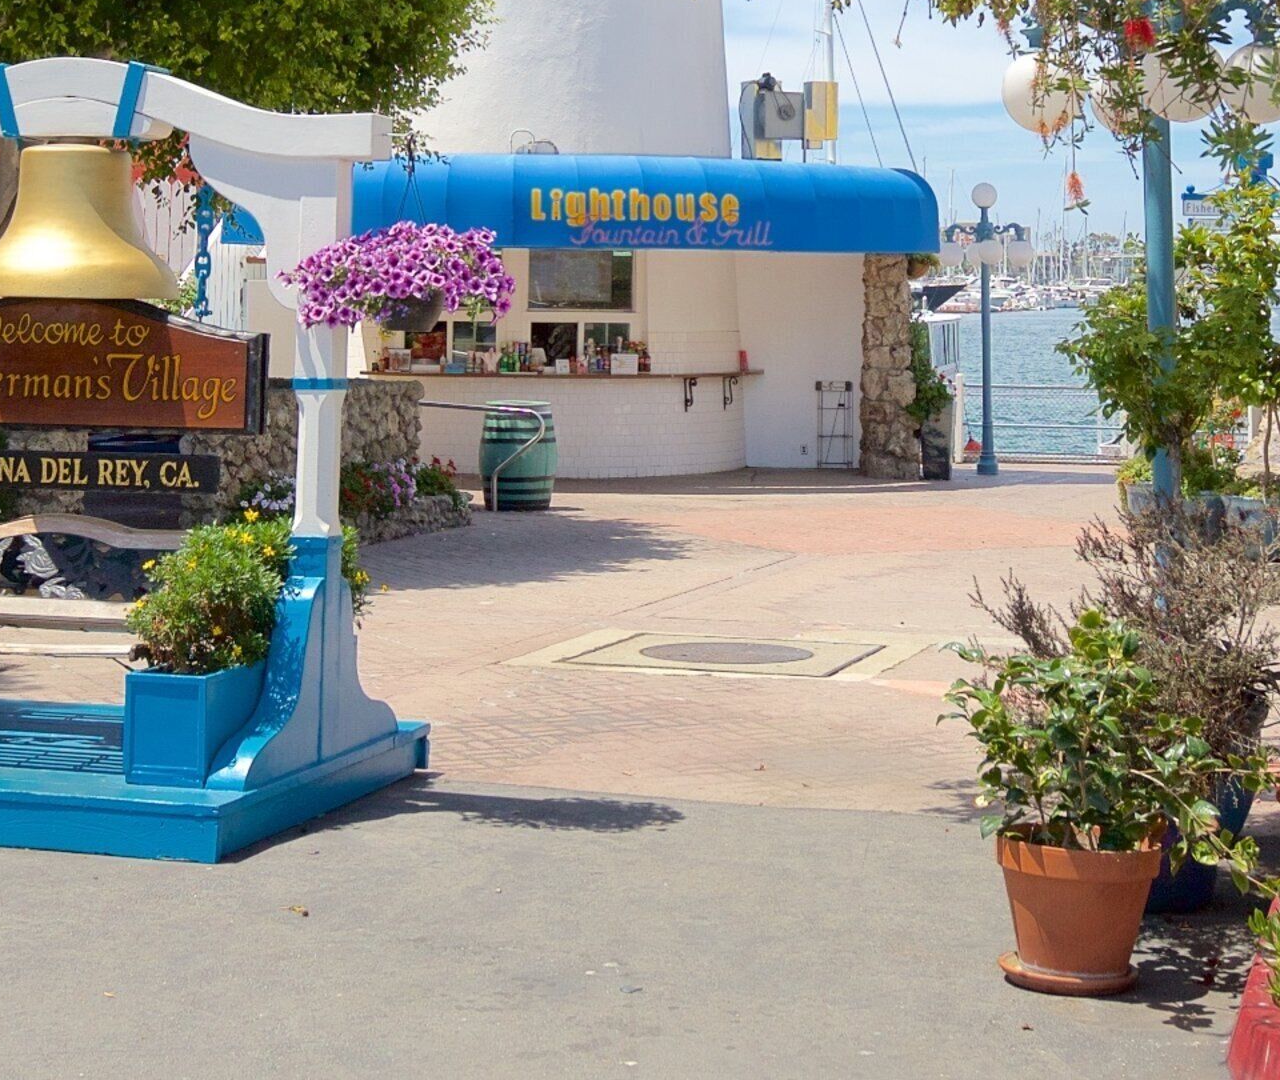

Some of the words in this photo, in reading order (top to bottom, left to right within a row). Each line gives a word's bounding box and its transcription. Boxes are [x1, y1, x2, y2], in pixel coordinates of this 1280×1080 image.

[530, 187, 740, 227] Lighthouse
[570, 214, 682, 246] Fountain
[711, 220, 774, 247] Grill
[109, 317, 151, 348] to
[107, 352, 238, 420] Village
[39, 457, 89, 485] DEL
[97, 459, 151, 489] REY,
[158, 460, 201, 488] CA.
